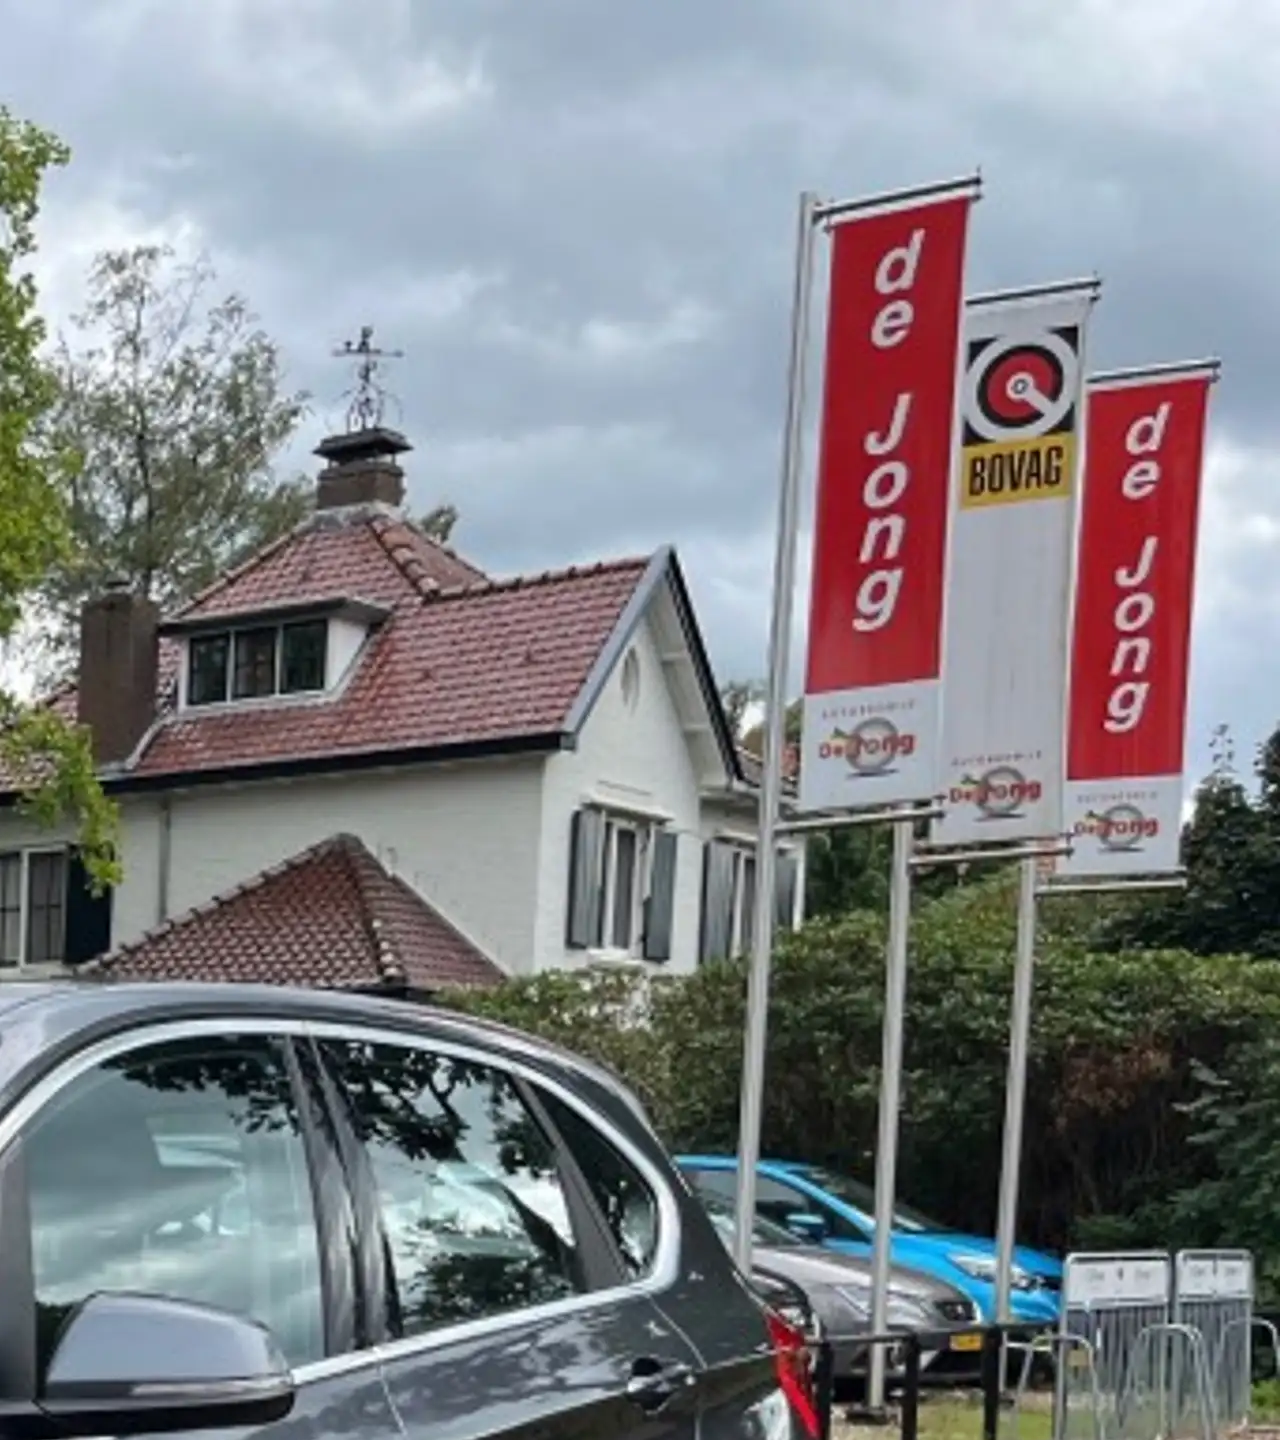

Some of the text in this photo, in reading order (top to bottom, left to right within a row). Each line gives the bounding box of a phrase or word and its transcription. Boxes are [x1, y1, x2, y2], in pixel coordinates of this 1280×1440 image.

[871, 228, 926, 348] de
[968, 446, 1064, 496] BOVAG
[1122, 402, 1172, 499] de
[852, 393, 912, 632] Jong
[1103, 536, 1159, 733] Jong
